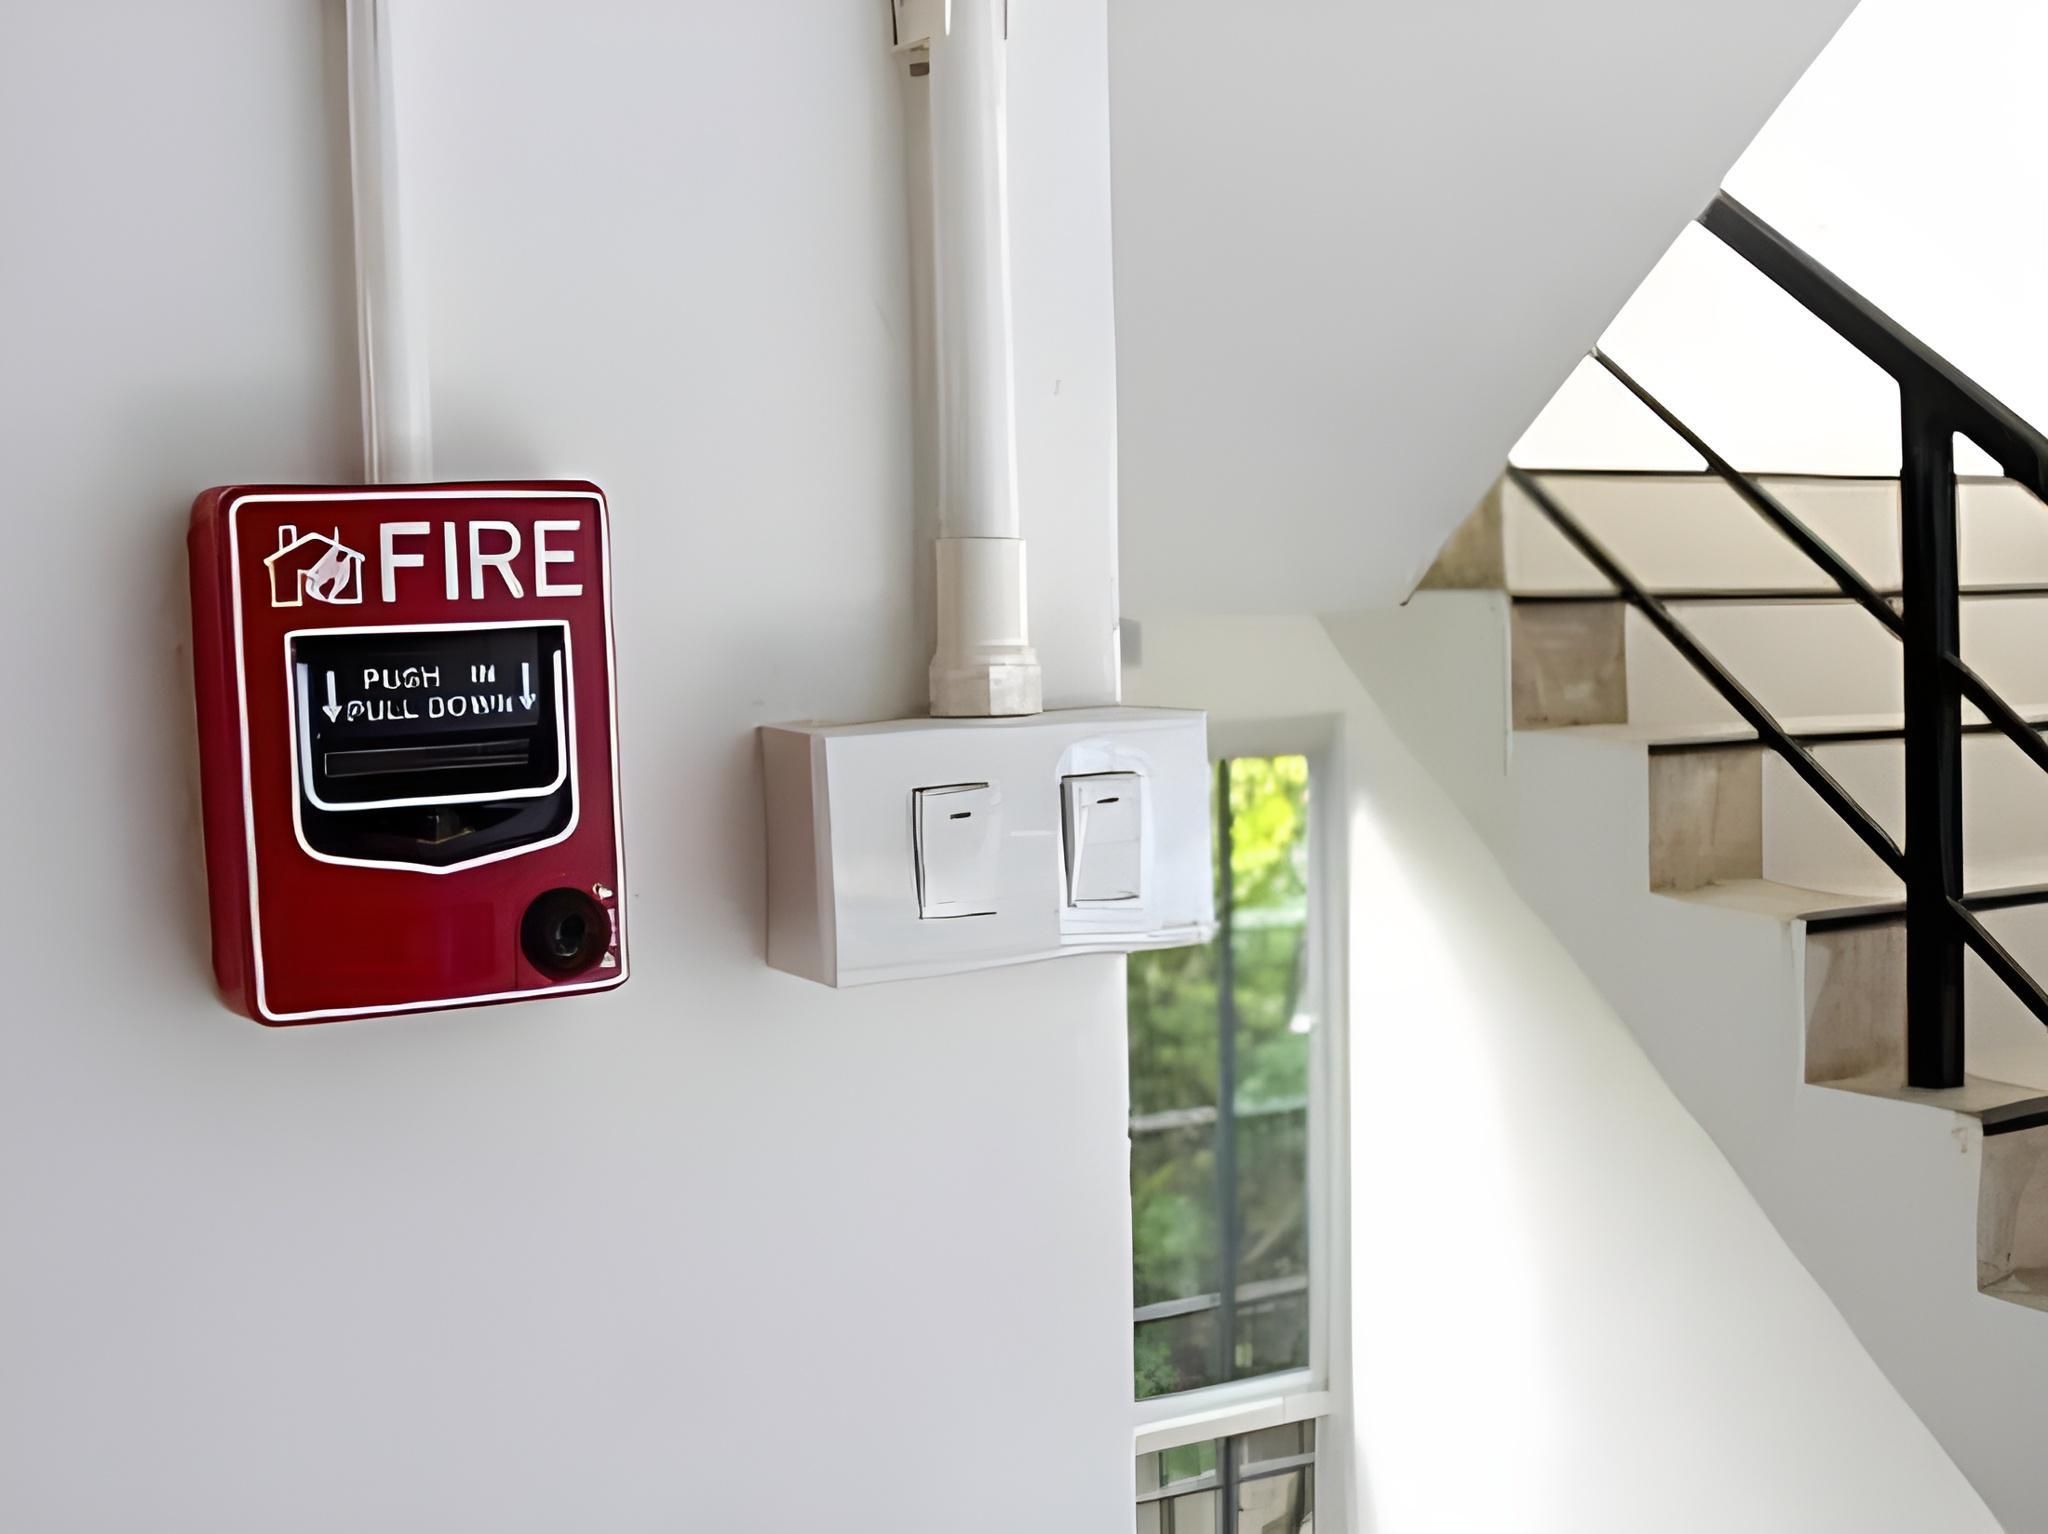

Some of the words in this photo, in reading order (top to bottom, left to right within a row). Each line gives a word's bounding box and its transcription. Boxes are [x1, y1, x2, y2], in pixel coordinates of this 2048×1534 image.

[379, 520, 584, 603] FIRE
[363, 665, 441, 690] PUSH
[470, 664, 497, 684] IN
[346, 698, 420, 722] PULL
